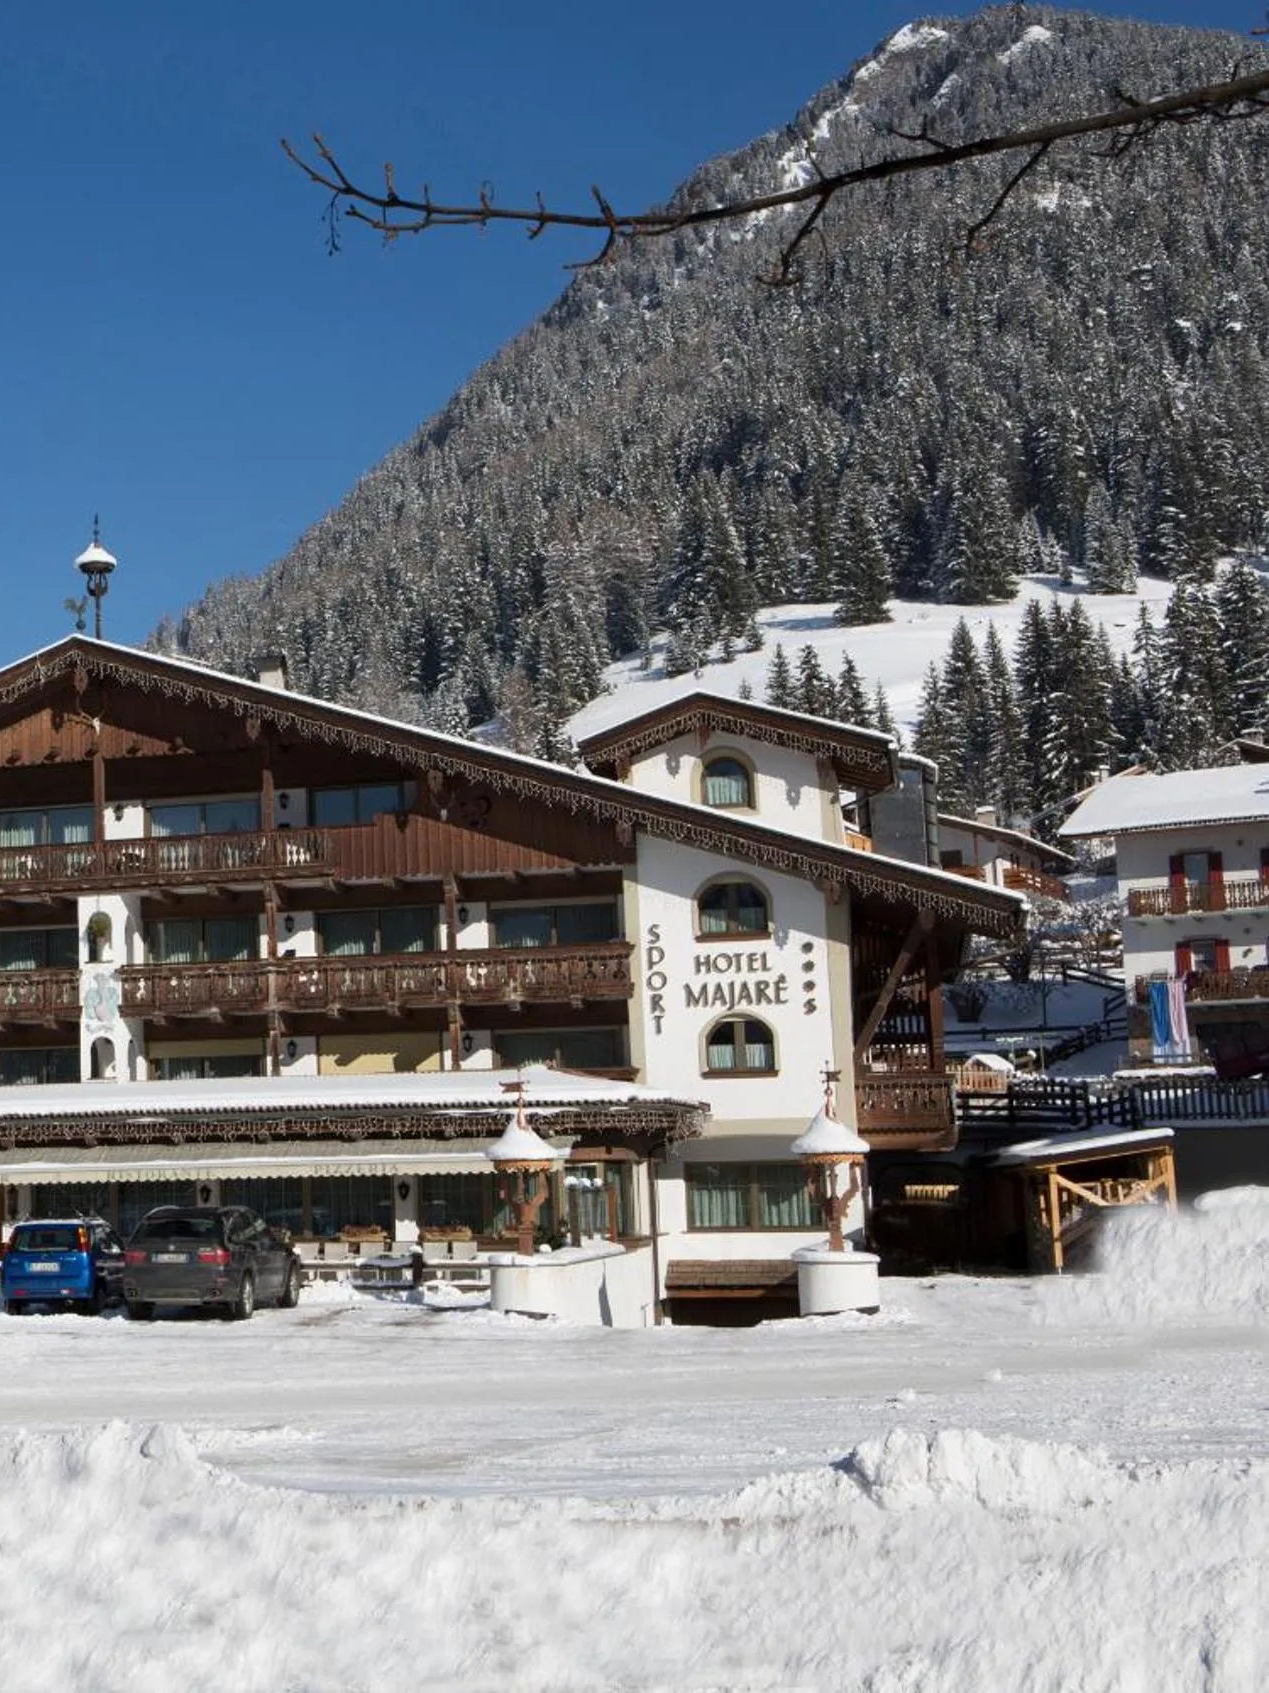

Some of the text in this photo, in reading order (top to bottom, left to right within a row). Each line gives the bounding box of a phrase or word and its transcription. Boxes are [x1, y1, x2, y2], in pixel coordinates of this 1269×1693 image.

[693, 952, 772, 976] HOTEL
[646, 923, 668, 1036] SPORT
[803, 998, 818, 1016] S
[313, 1163, 399, 1175] PIZZERIA
